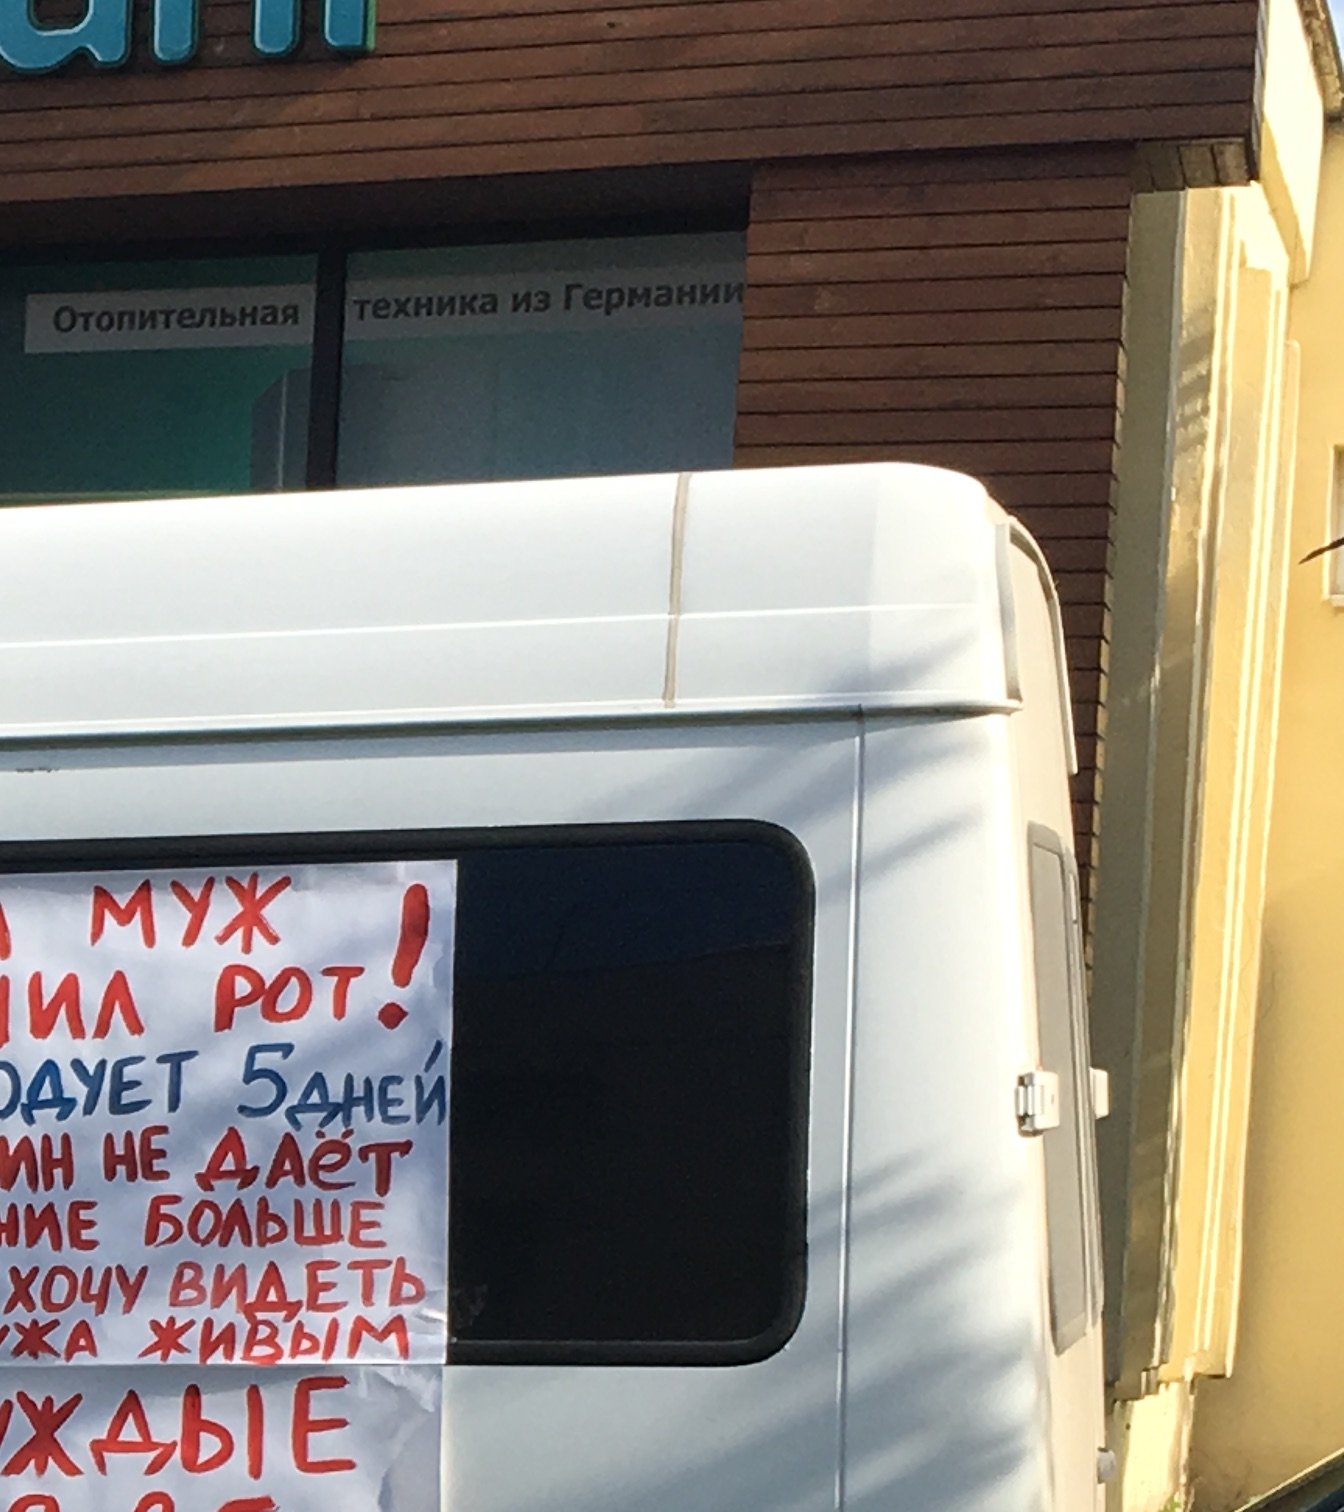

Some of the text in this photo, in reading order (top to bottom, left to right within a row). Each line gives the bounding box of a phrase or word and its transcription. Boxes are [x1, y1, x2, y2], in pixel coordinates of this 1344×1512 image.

[52, 280, 742, 335] Отопительная техника из Германии
[90, 871, 293, 955] МУЖ
[104, 1125, 171, 1183] НЕ
[144, 1195, 387, 1250] БОЛЬШЕ
[3, 1263, 148, 1315] ХОЧУ
[170, 1256, 426, 1323] ВИДЕТЬ
[138, 1315, 410, 1365] ЖИВЫМ
